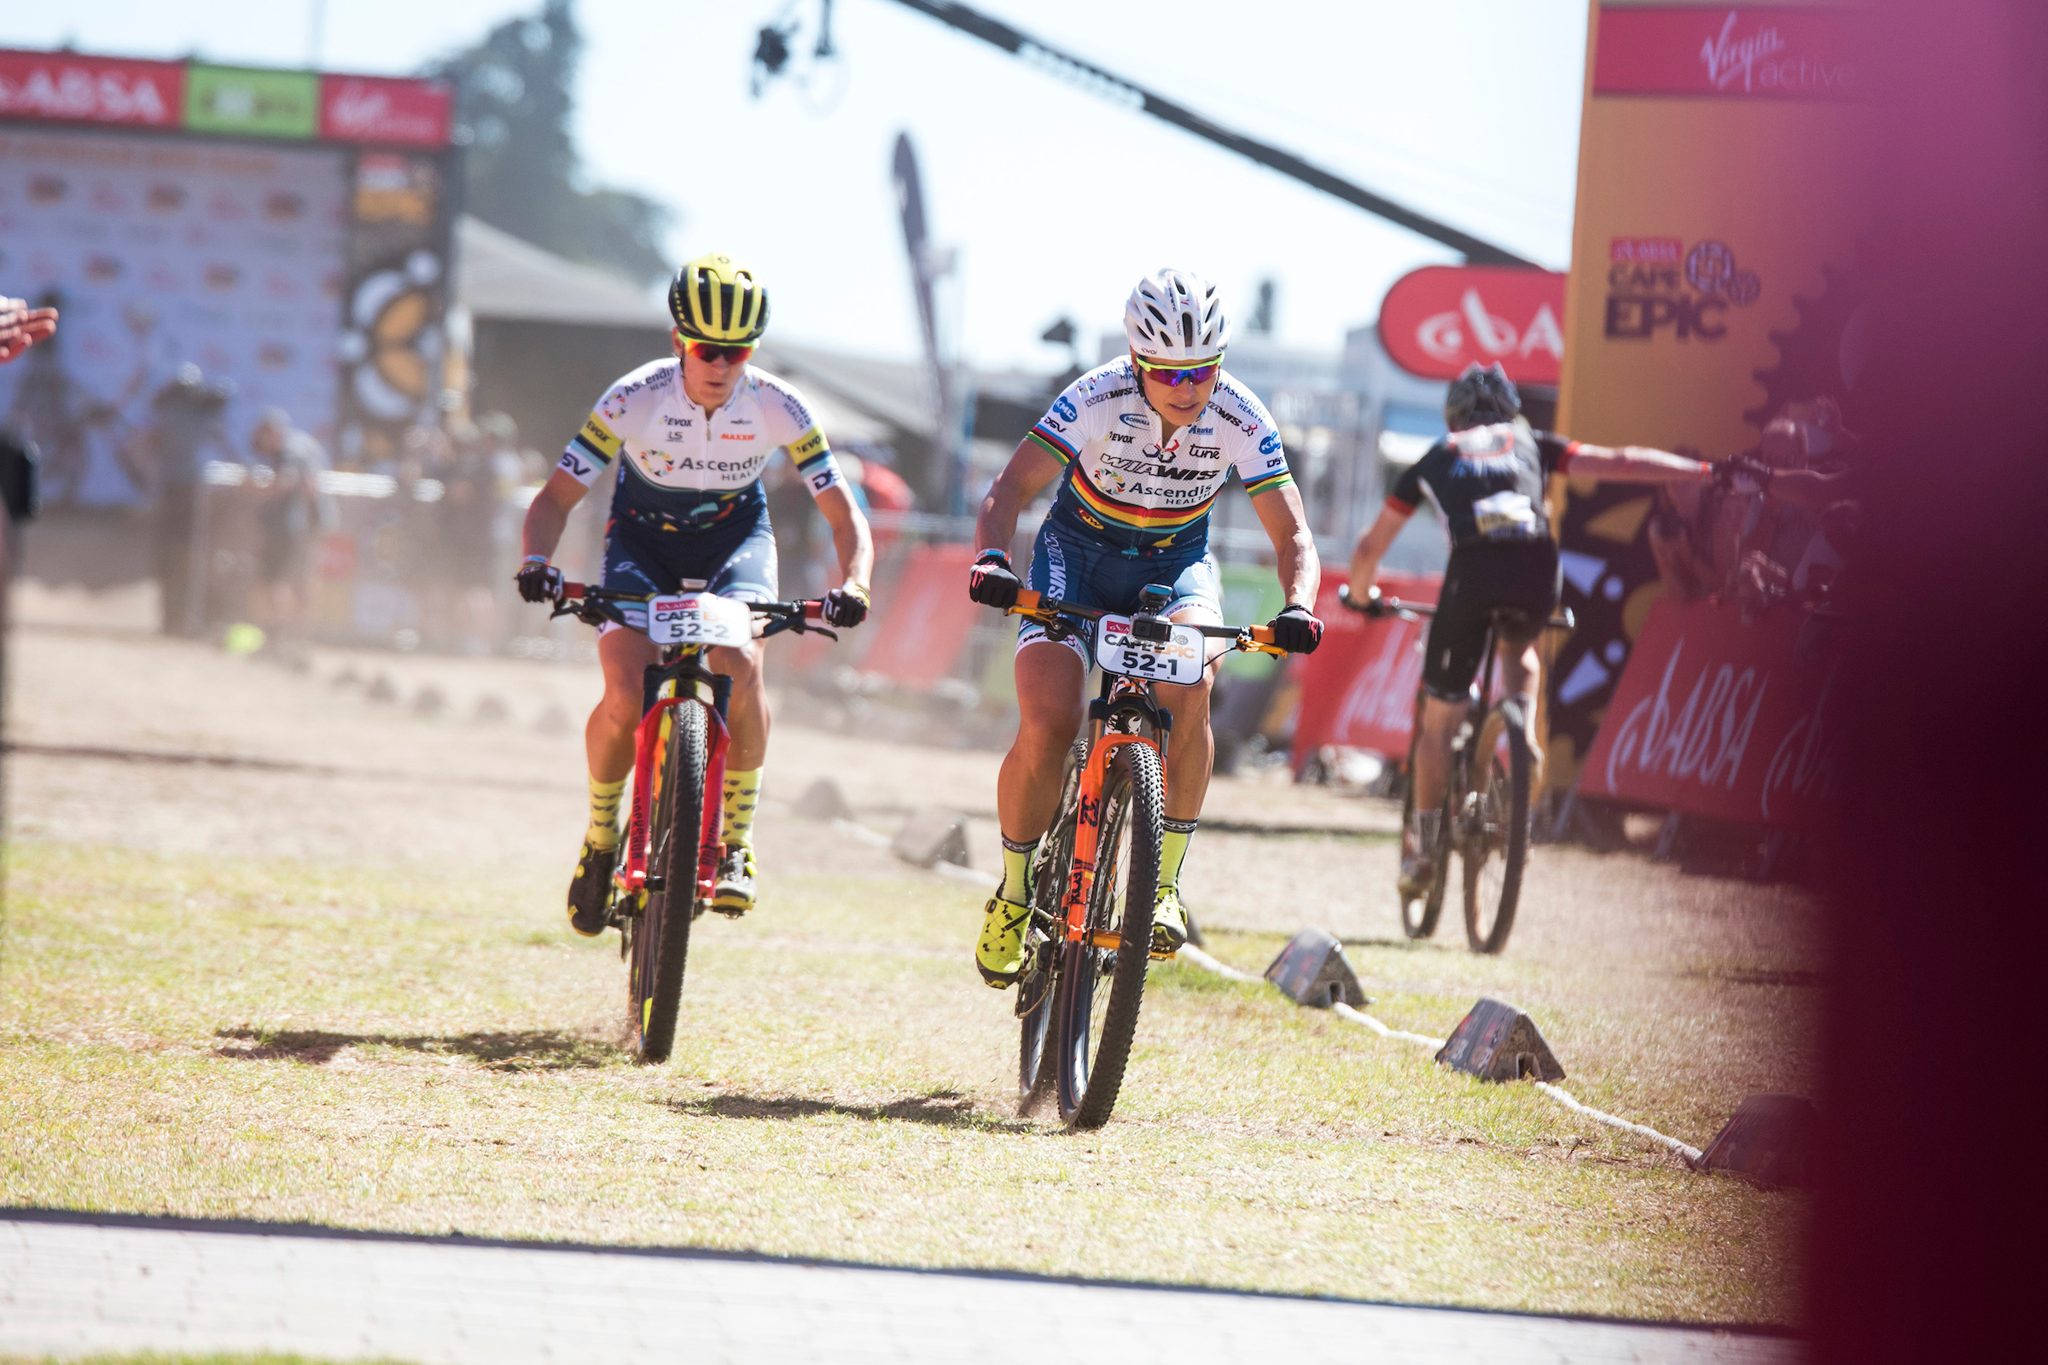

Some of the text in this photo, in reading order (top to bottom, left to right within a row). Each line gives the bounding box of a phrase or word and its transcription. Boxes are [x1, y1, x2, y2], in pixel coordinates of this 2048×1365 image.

[1700, 10, 1784, 92] Virgin
[1604, 295, 1730, 340] EPIC
[1055, 400, 1076, 421] KMC
[586, 420, 611, 443] EVOX
[1044, 416, 1067, 433] DSV
[801, 435, 822, 454] EVO
[1111, 433, 1137, 445] EVOX
[1189, 443, 1221, 460] tune
[1100, 453, 1221, 481] WIAWIS
[1128, 482, 1212, 498] Ascendis
[655, 610, 701, 623] CAPE
[670, 623, 730, 639] 52-2
[1121, 650, 1178, 676] 52-1
[1079, 793, 1101, 828] 32
